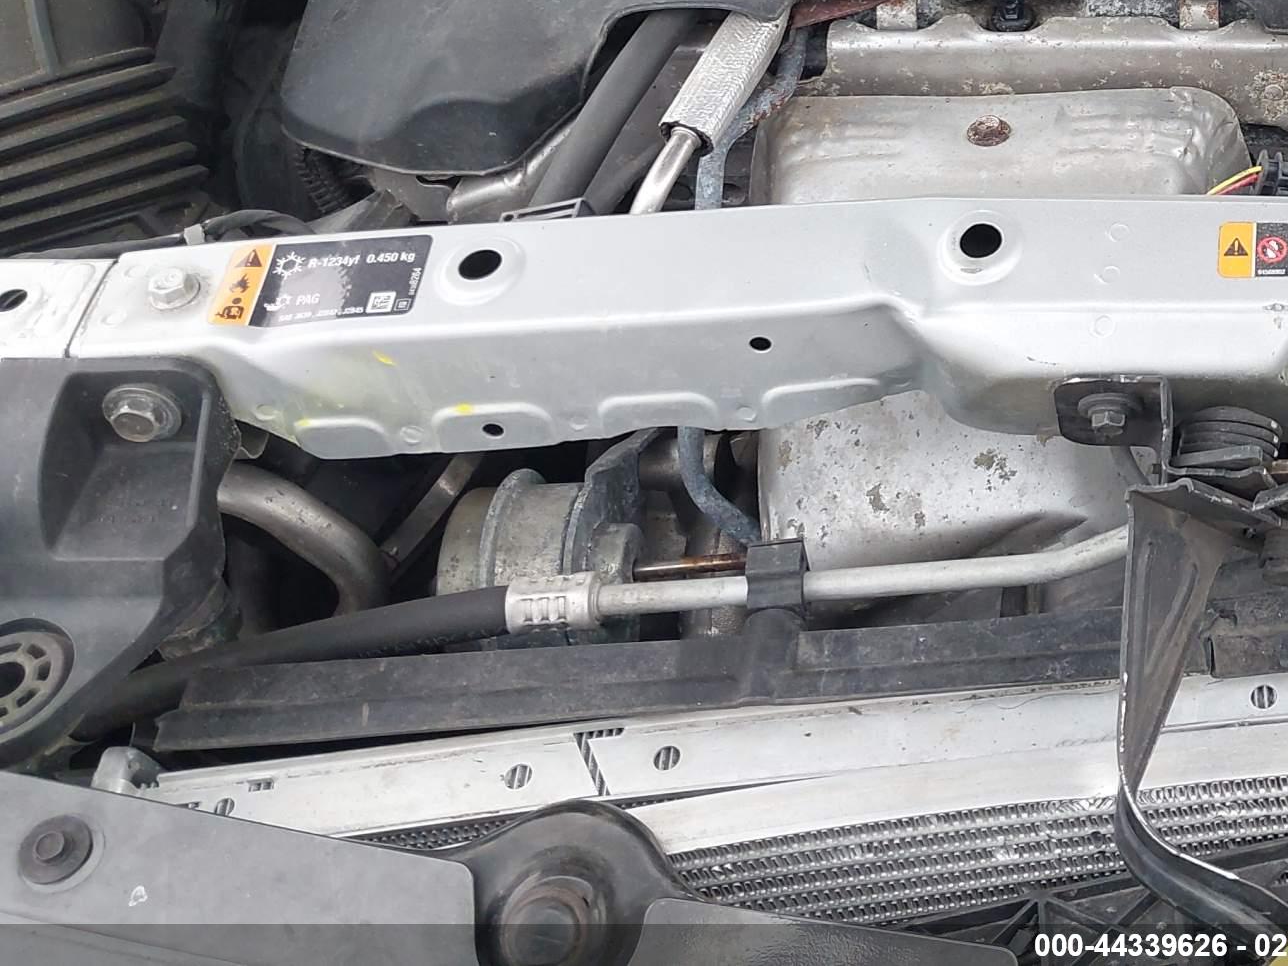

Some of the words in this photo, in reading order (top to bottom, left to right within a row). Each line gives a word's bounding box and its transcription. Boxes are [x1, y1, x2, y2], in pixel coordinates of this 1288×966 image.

[307, 254, 360, 269] R-1234yf
[366, 253, 398, 264] 0.450
[400, 252, 416, 263] kg
[295, 293, 320, 306] PAG
